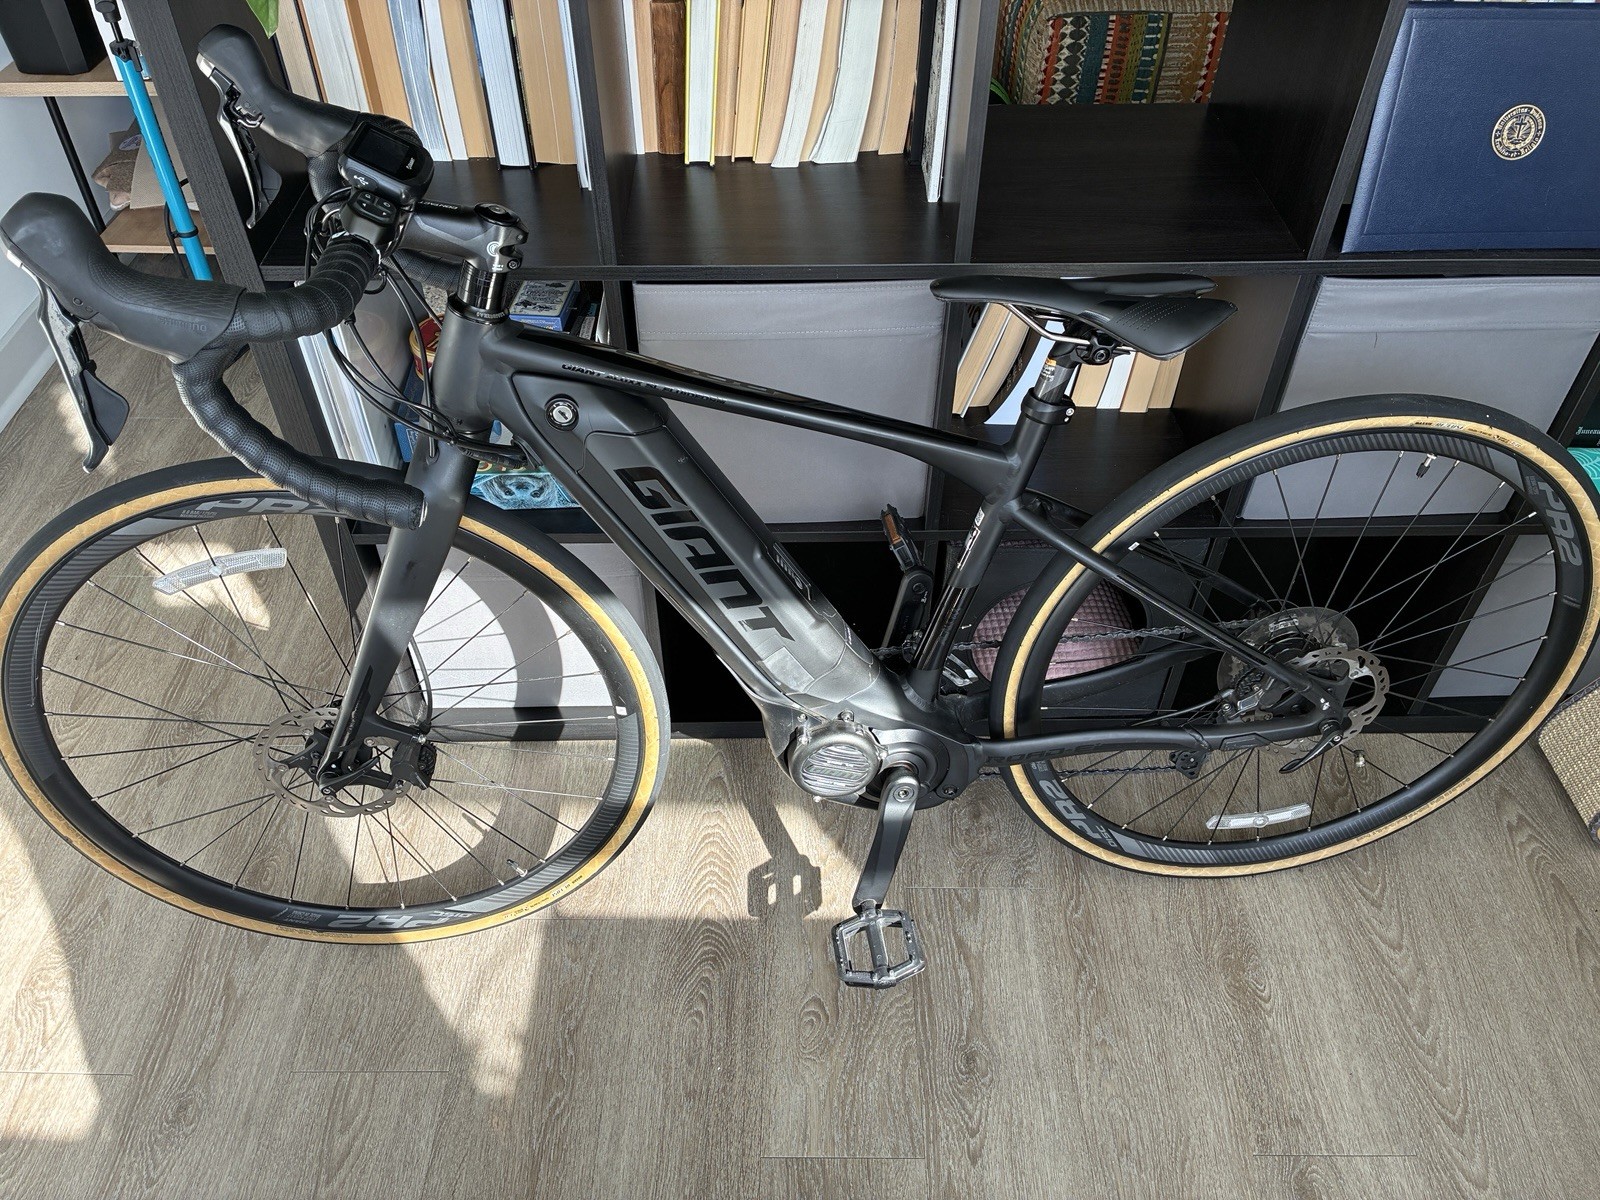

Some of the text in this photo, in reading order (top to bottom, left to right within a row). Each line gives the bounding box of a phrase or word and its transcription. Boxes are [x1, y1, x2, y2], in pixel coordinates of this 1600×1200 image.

[561, 364, 605, 377] GIANT
[1537, 481, 1583, 566] PR2
[613, 466, 796, 642] GIANT
[1038, 779, 1103, 840] PR2
[1095, 825, 1118, 848] DISC
[328, 913, 450, 929] PR2
